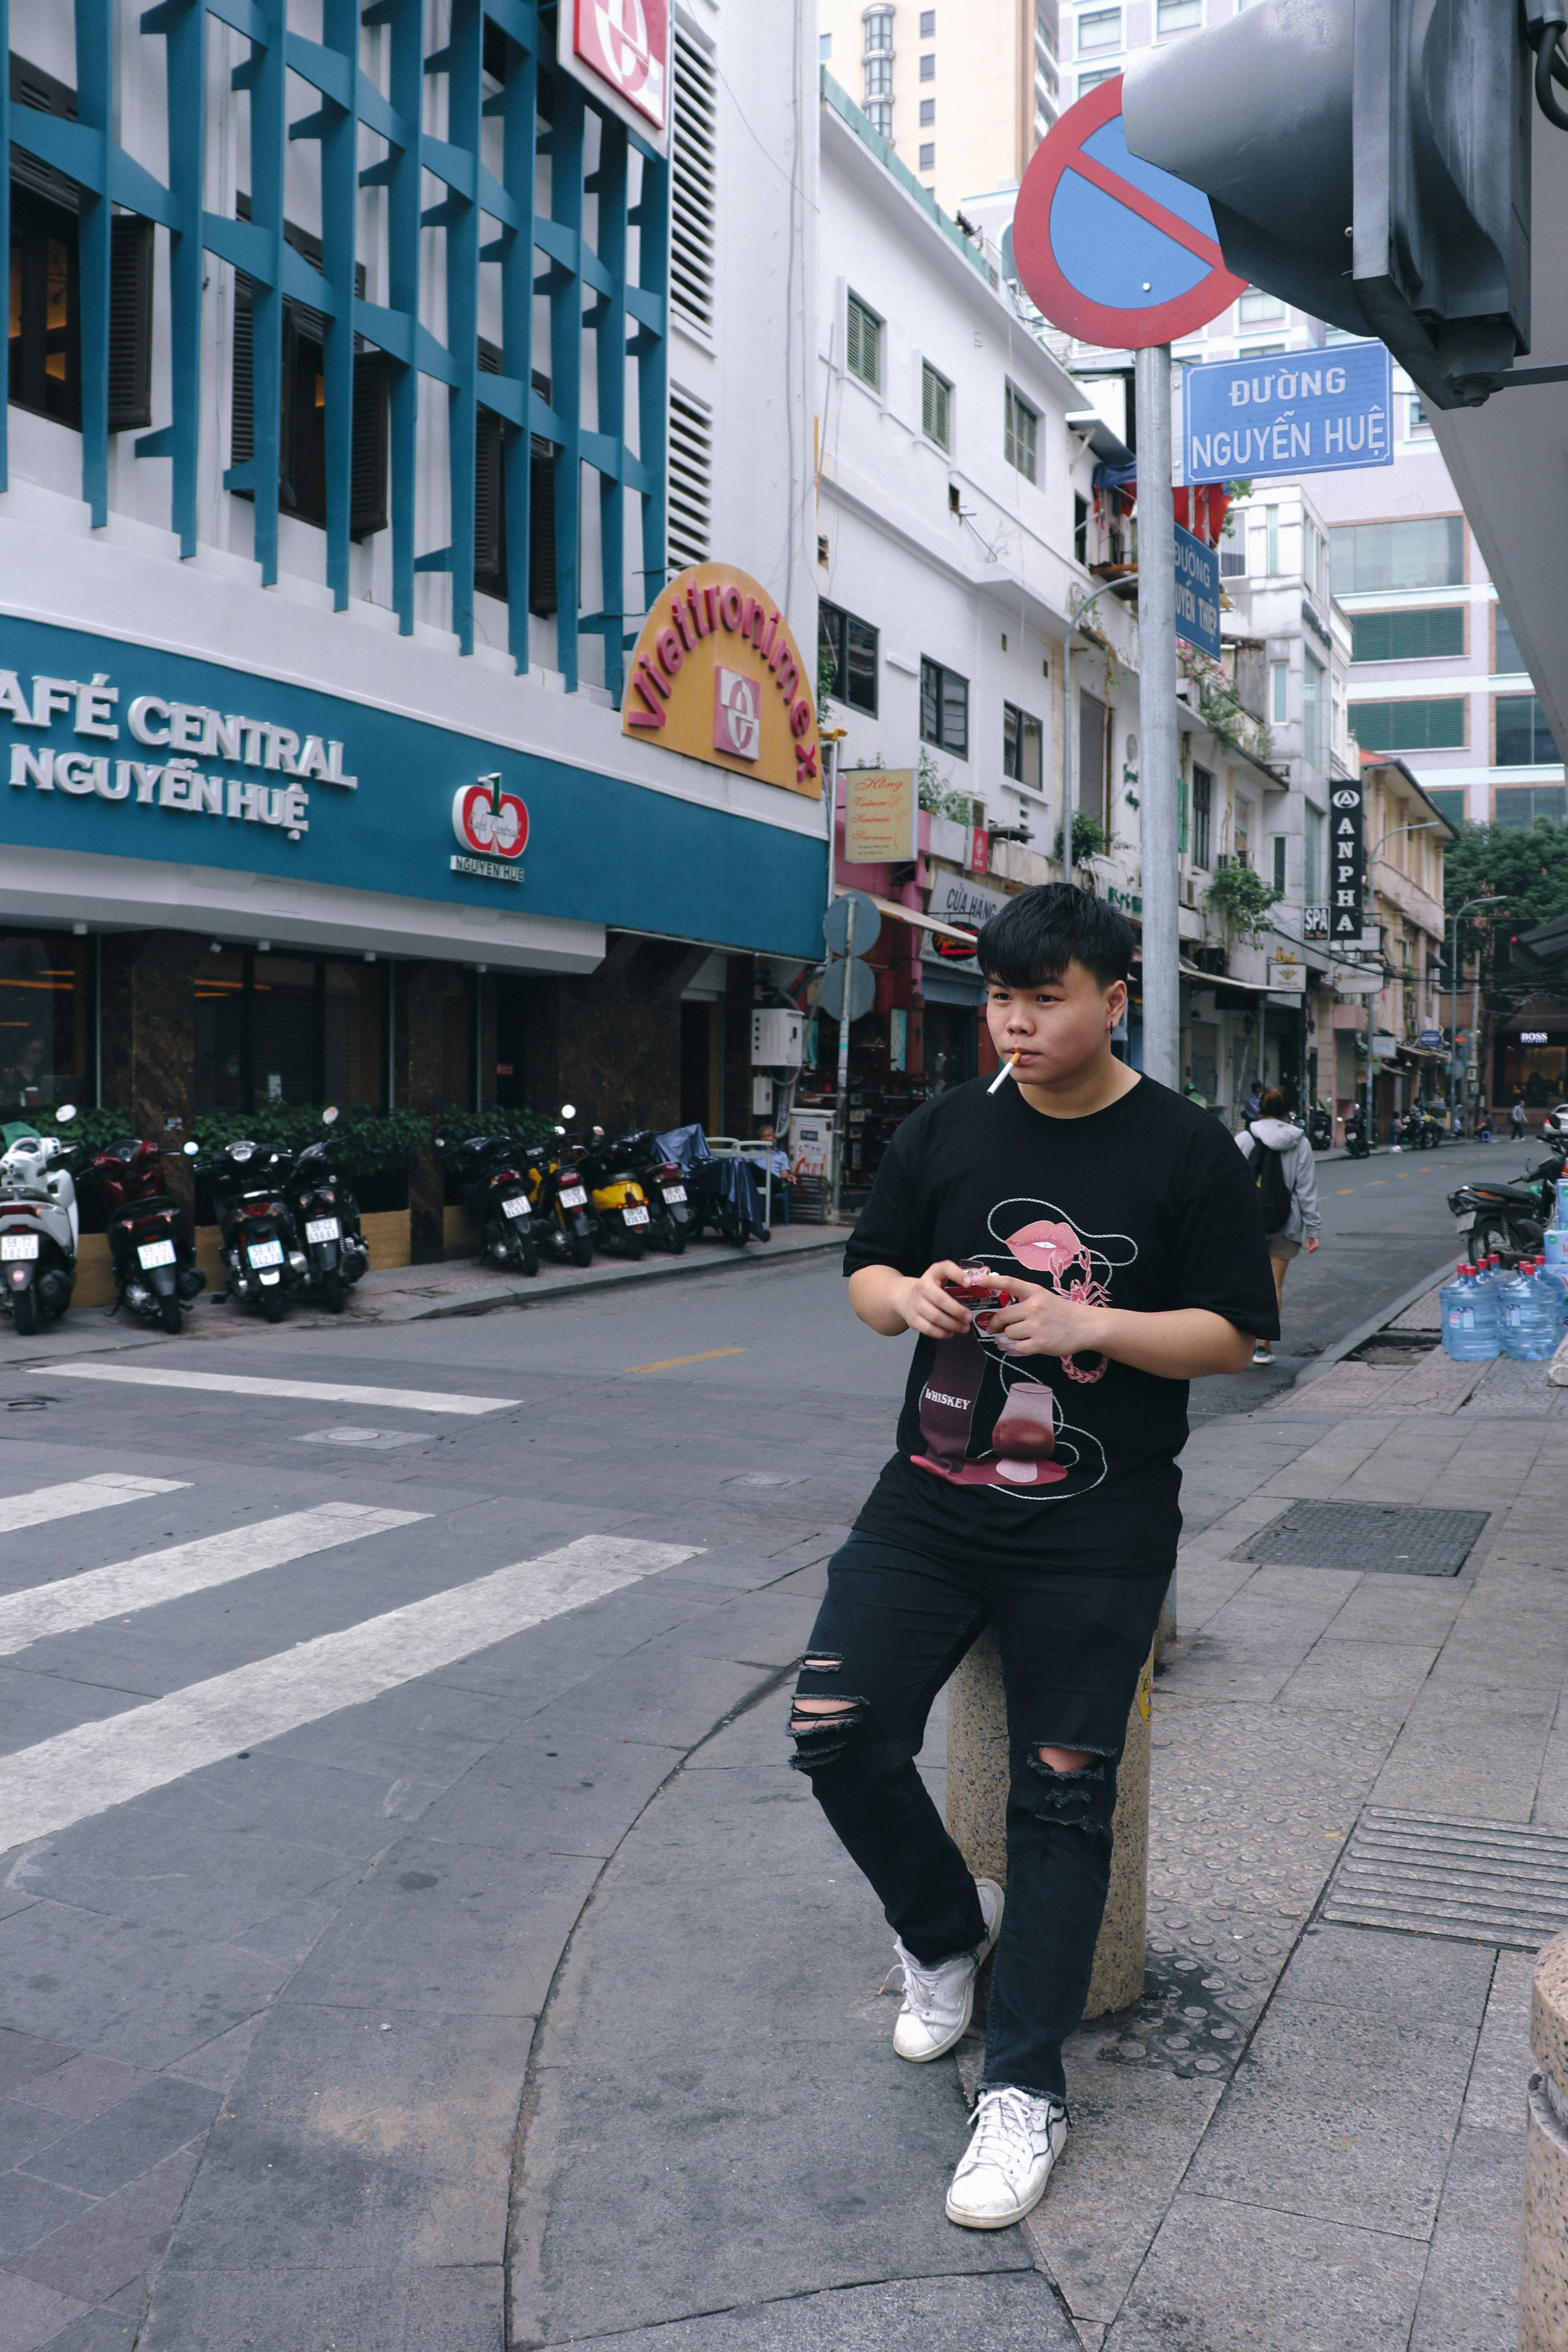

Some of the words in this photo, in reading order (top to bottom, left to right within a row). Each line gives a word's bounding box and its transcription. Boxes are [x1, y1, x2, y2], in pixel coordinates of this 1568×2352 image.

[1229, 367, 1345, 406] ĐƯỜNG
[1192, 410, 1310, 469] NGUYỄN
[1325, 404, 1385, 456] HUỆ
[629, 579, 816, 782] Vietronimex
[128, 696, 357, 789] CENTRAL
[9, 744, 223, 815] NGUYỄN
[227, 783, 309, 840] HUỆ
[457, 857, 499, 877] NGUYEN
[504, 865, 523, 881] HUE
[947, 883, 967, 912] CỬA
[1306, 908, 1328, 930] SPA
[925, 1388, 971, 1410] WHISKEY
